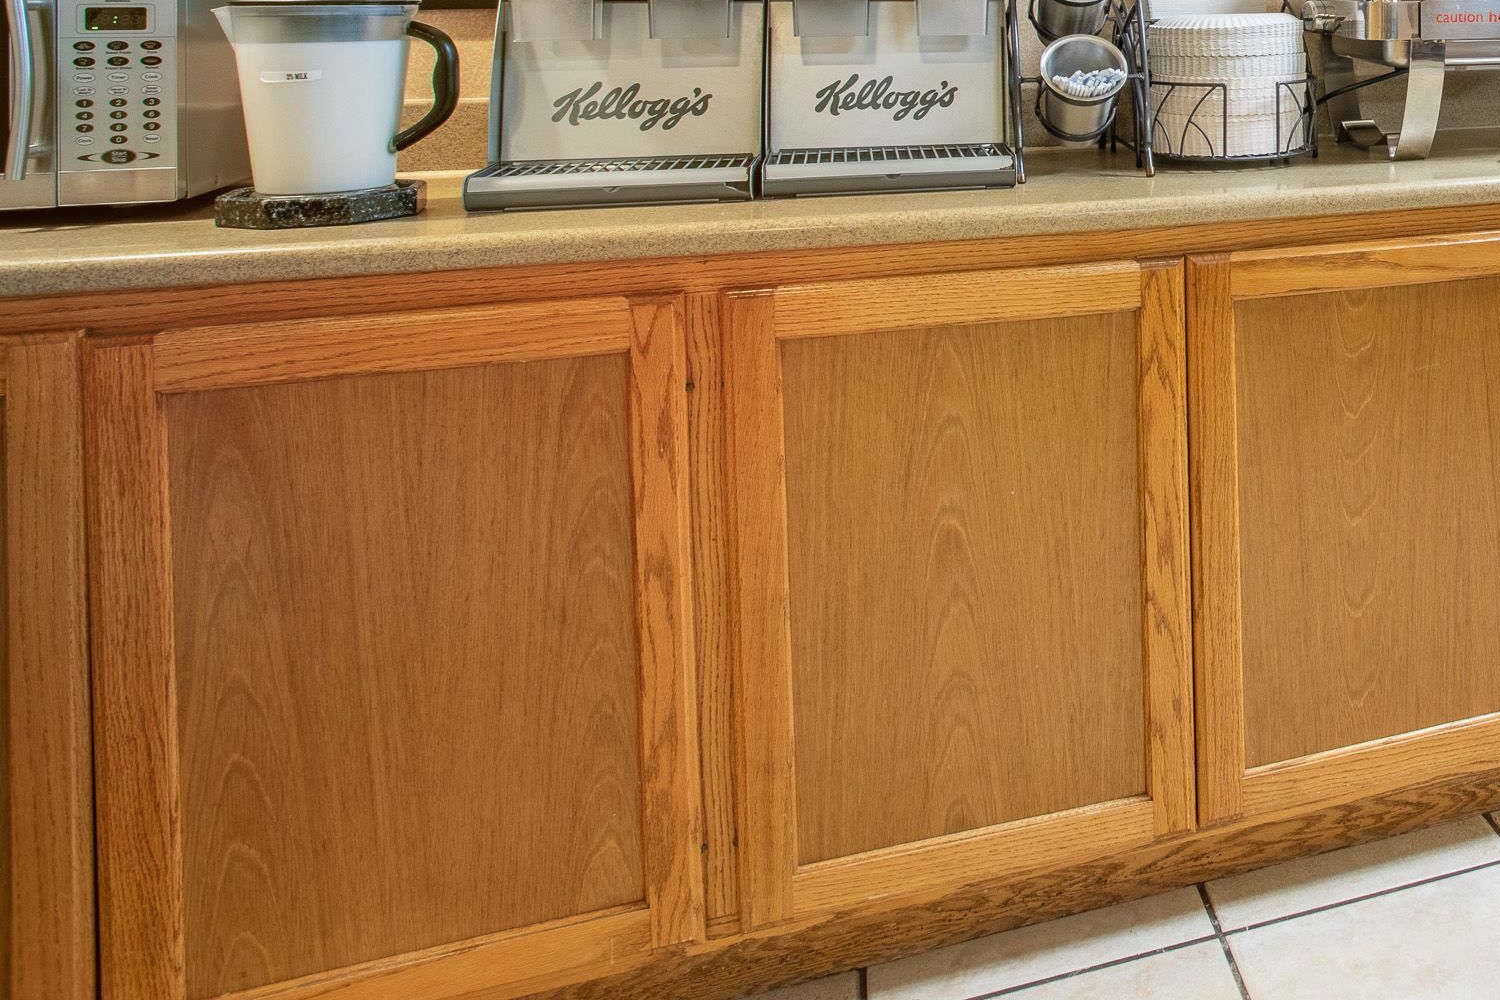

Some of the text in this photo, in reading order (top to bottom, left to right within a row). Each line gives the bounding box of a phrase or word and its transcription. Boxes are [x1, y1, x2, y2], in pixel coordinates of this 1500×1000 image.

[1436, 12, 1484, 23] caution
[551, 81, 713, 131] Kellogg's
[815, 73, 958, 122] Kellogg's
